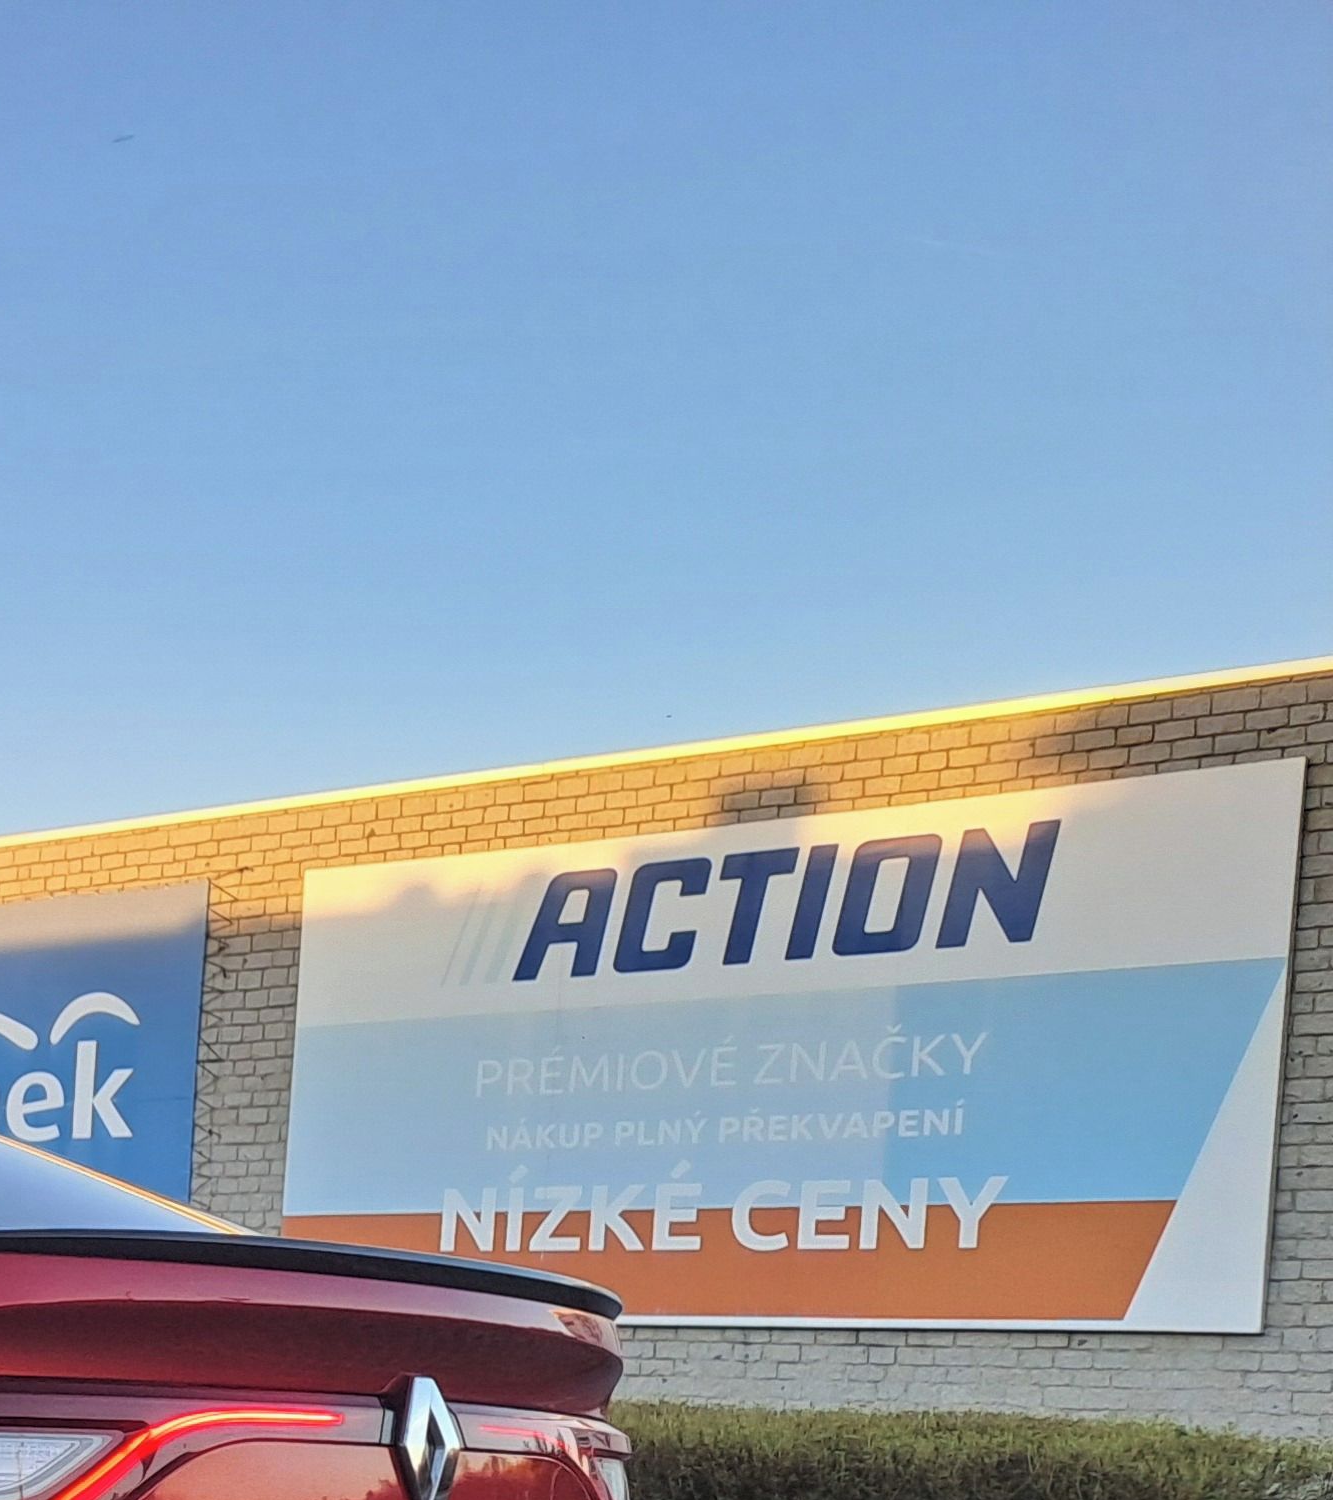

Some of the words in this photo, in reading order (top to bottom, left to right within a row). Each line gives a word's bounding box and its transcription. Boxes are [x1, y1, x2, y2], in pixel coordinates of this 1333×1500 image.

[513, 819, 1061, 981] ACTION
[475, 1034, 736, 1098] PRÉMIOVÉ
[753, 1022, 989, 1084] ZNAČKY
[485, 1114, 603, 1151] NÁKUP
[613, 1110, 707, 1147] PLNÝ
[719, 1099, 964, 1144] PŘEKVAPENÍ
[440, 1159, 702, 1253] NÍZKÉ
[730, 1175, 1009, 1249] CENY
